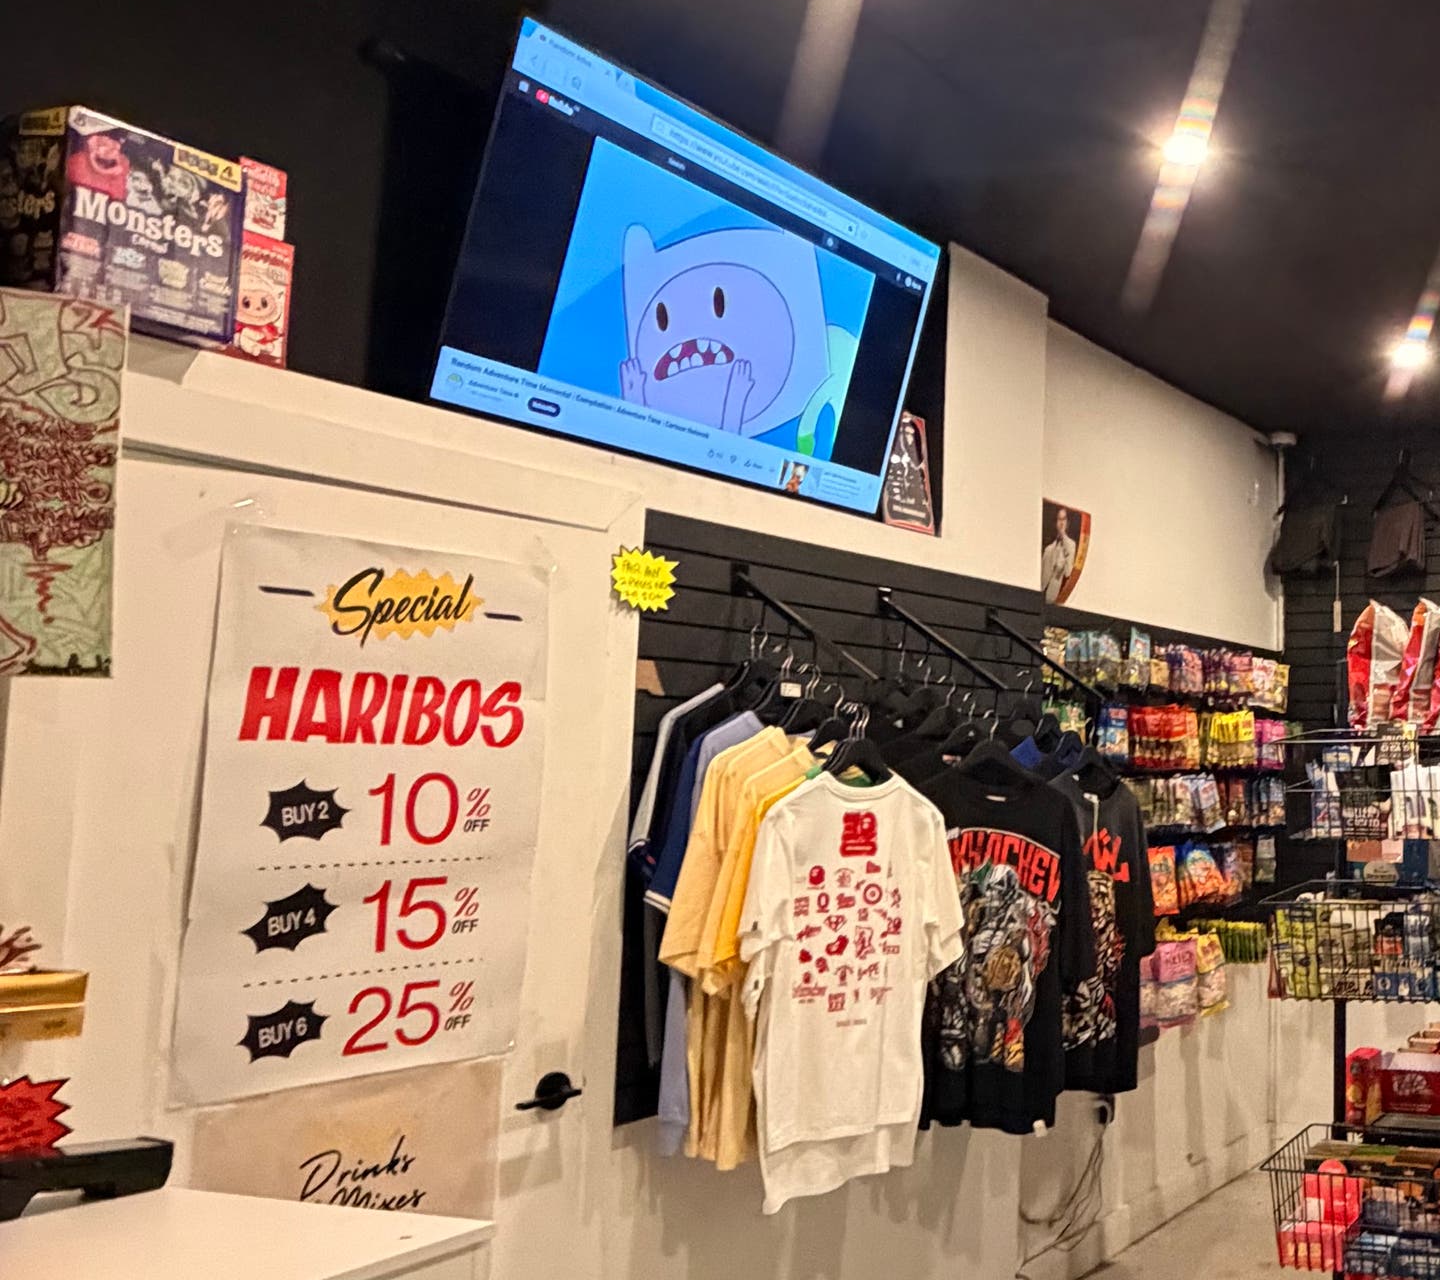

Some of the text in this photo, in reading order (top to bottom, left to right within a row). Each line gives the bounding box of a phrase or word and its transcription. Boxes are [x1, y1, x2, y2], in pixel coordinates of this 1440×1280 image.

[73, 186, 224, 258] Monsters
[331, 567, 474, 649] Special
[237, 666, 525, 749] HARIBOS
[281, 800, 330, 827] BUY 2
[463, 819, 490, 833] OFF
[267, 908, 316, 937] BUY 4
[451, 919, 479, 935] OFF
[257, 1016, 308, 1049] BUY 6
[444, 1014, 472, 1032] OFF
[299, 1134, 417, 1202] Drinks
[328, 1185, 428, 1212] Mixes
